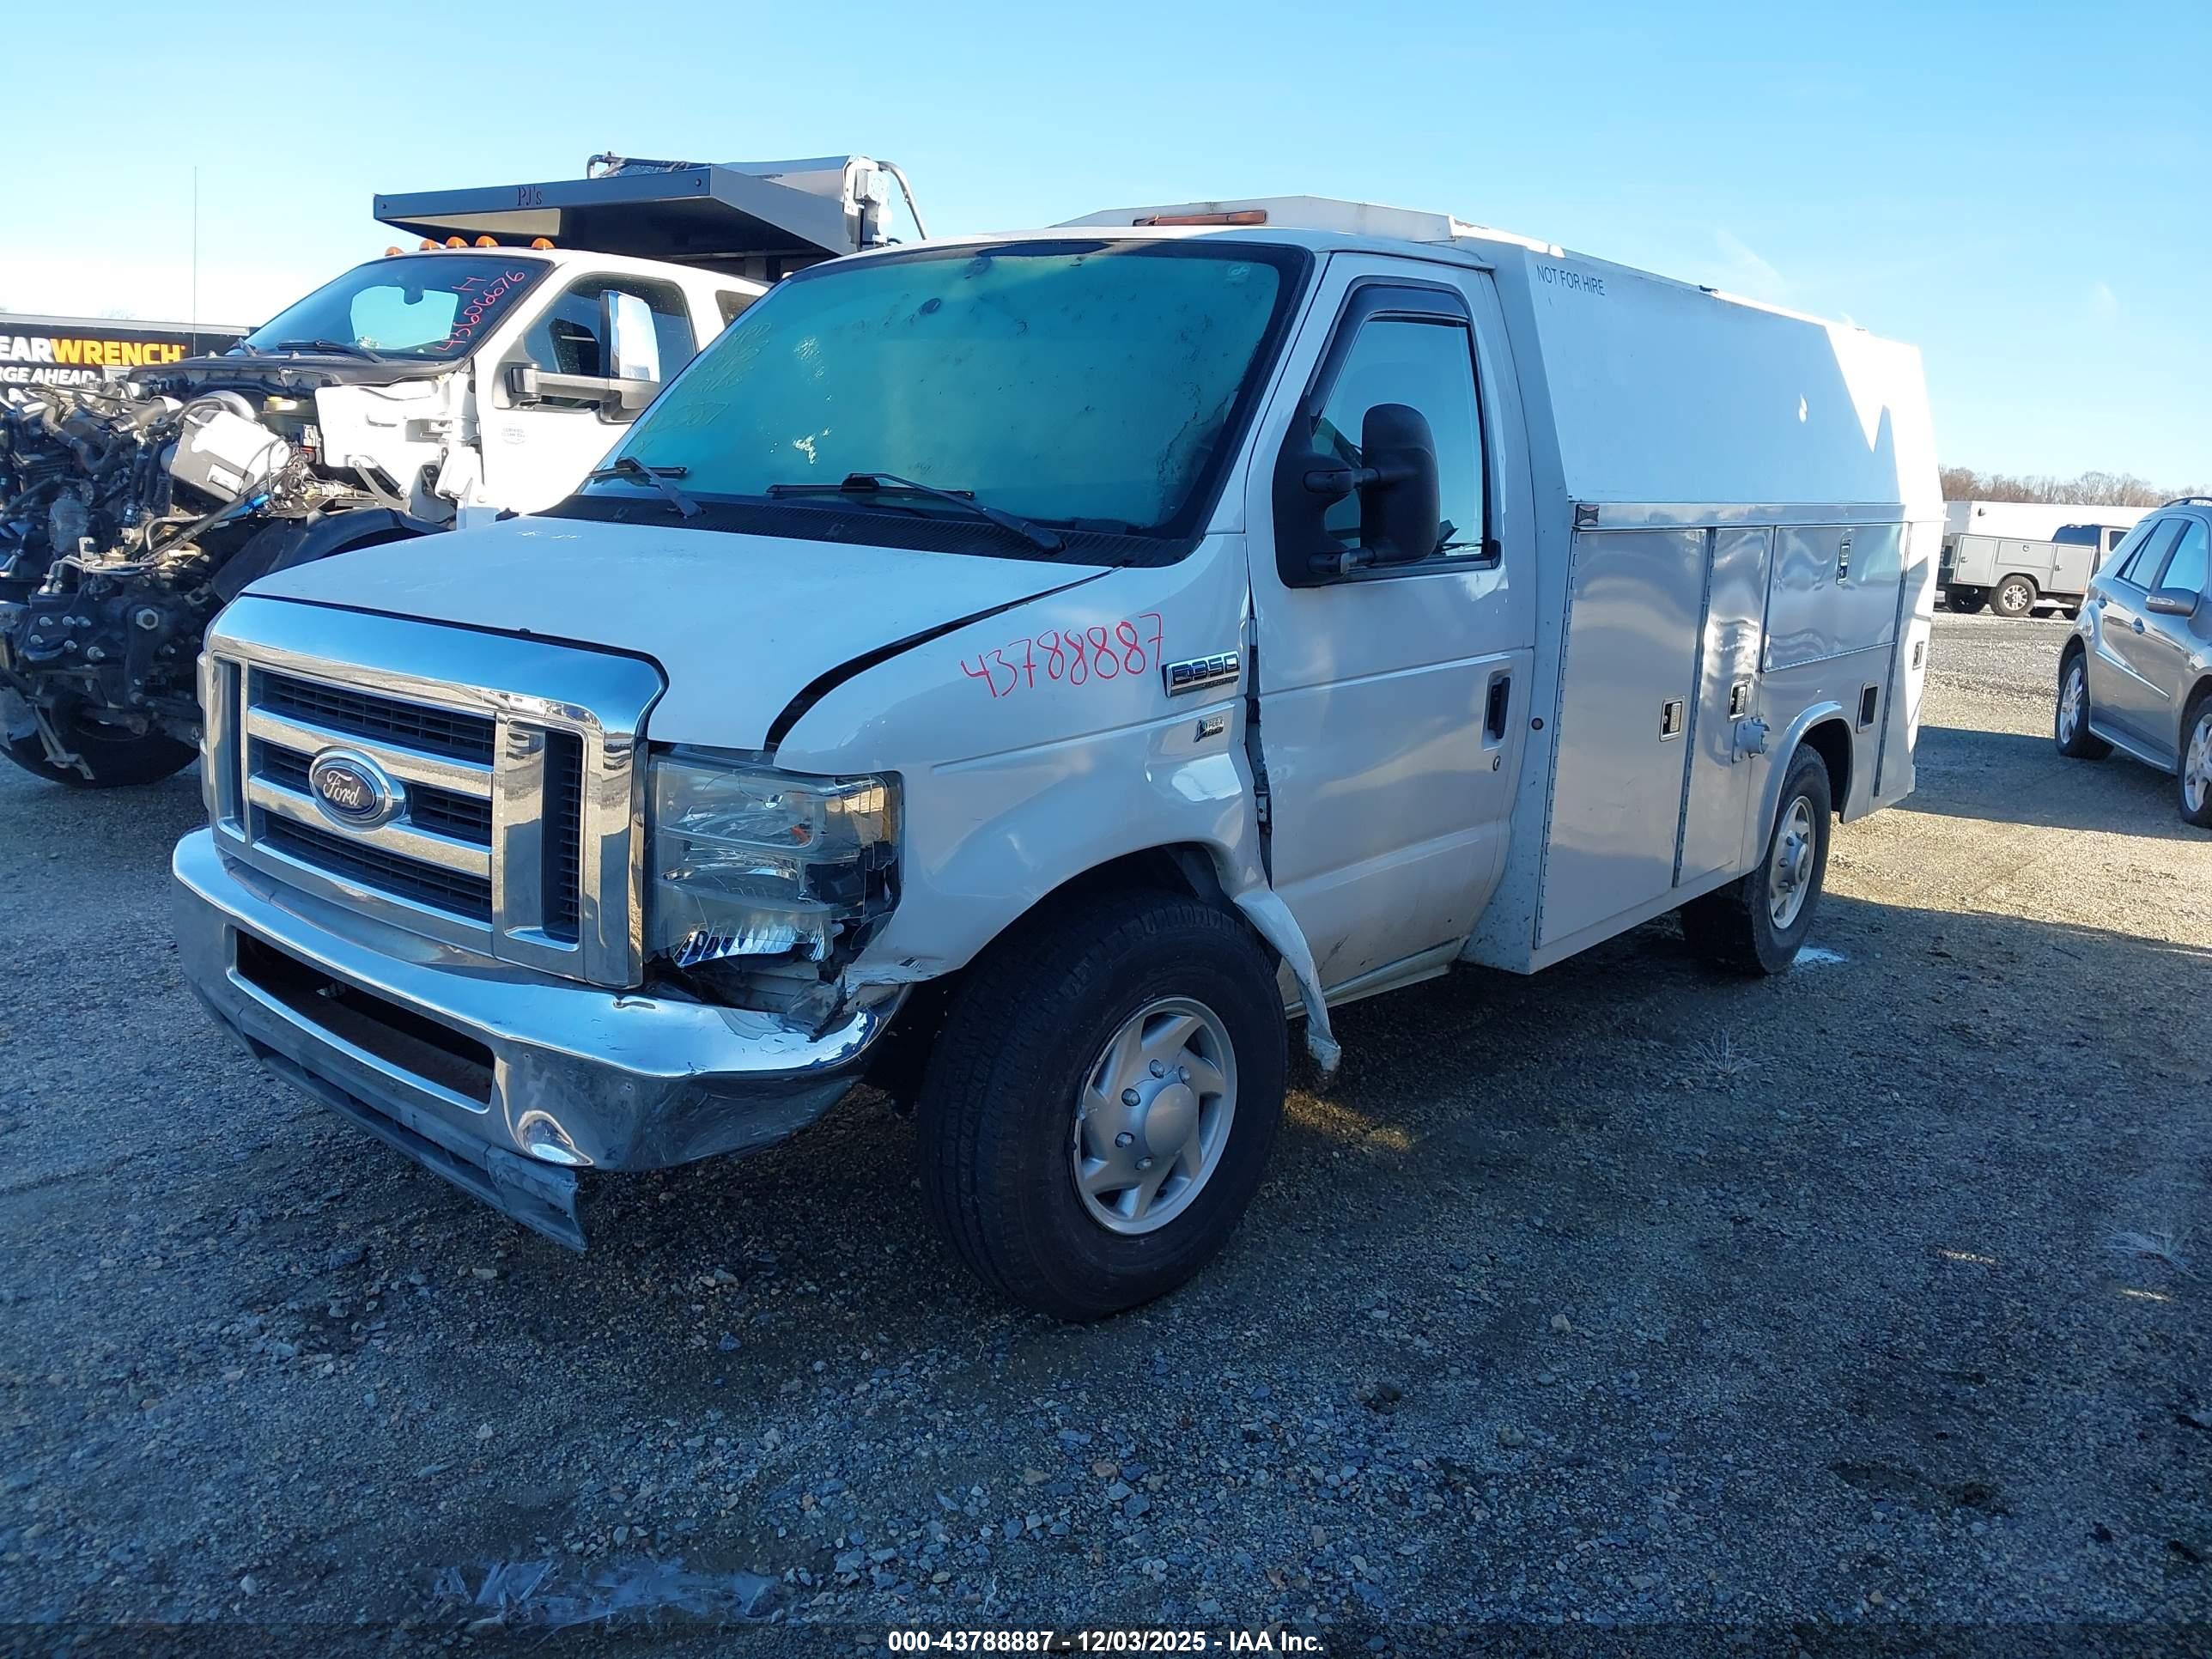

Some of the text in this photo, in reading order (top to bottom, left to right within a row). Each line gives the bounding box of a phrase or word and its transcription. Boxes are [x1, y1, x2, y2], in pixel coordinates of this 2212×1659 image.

[517, 185, 543, 206] PJ's
[1536, 264, 1606, 296] NOT FOR HIRE
[960, 612, 1164, 698] 43788887
[323, 770, 361, 806] Ford
